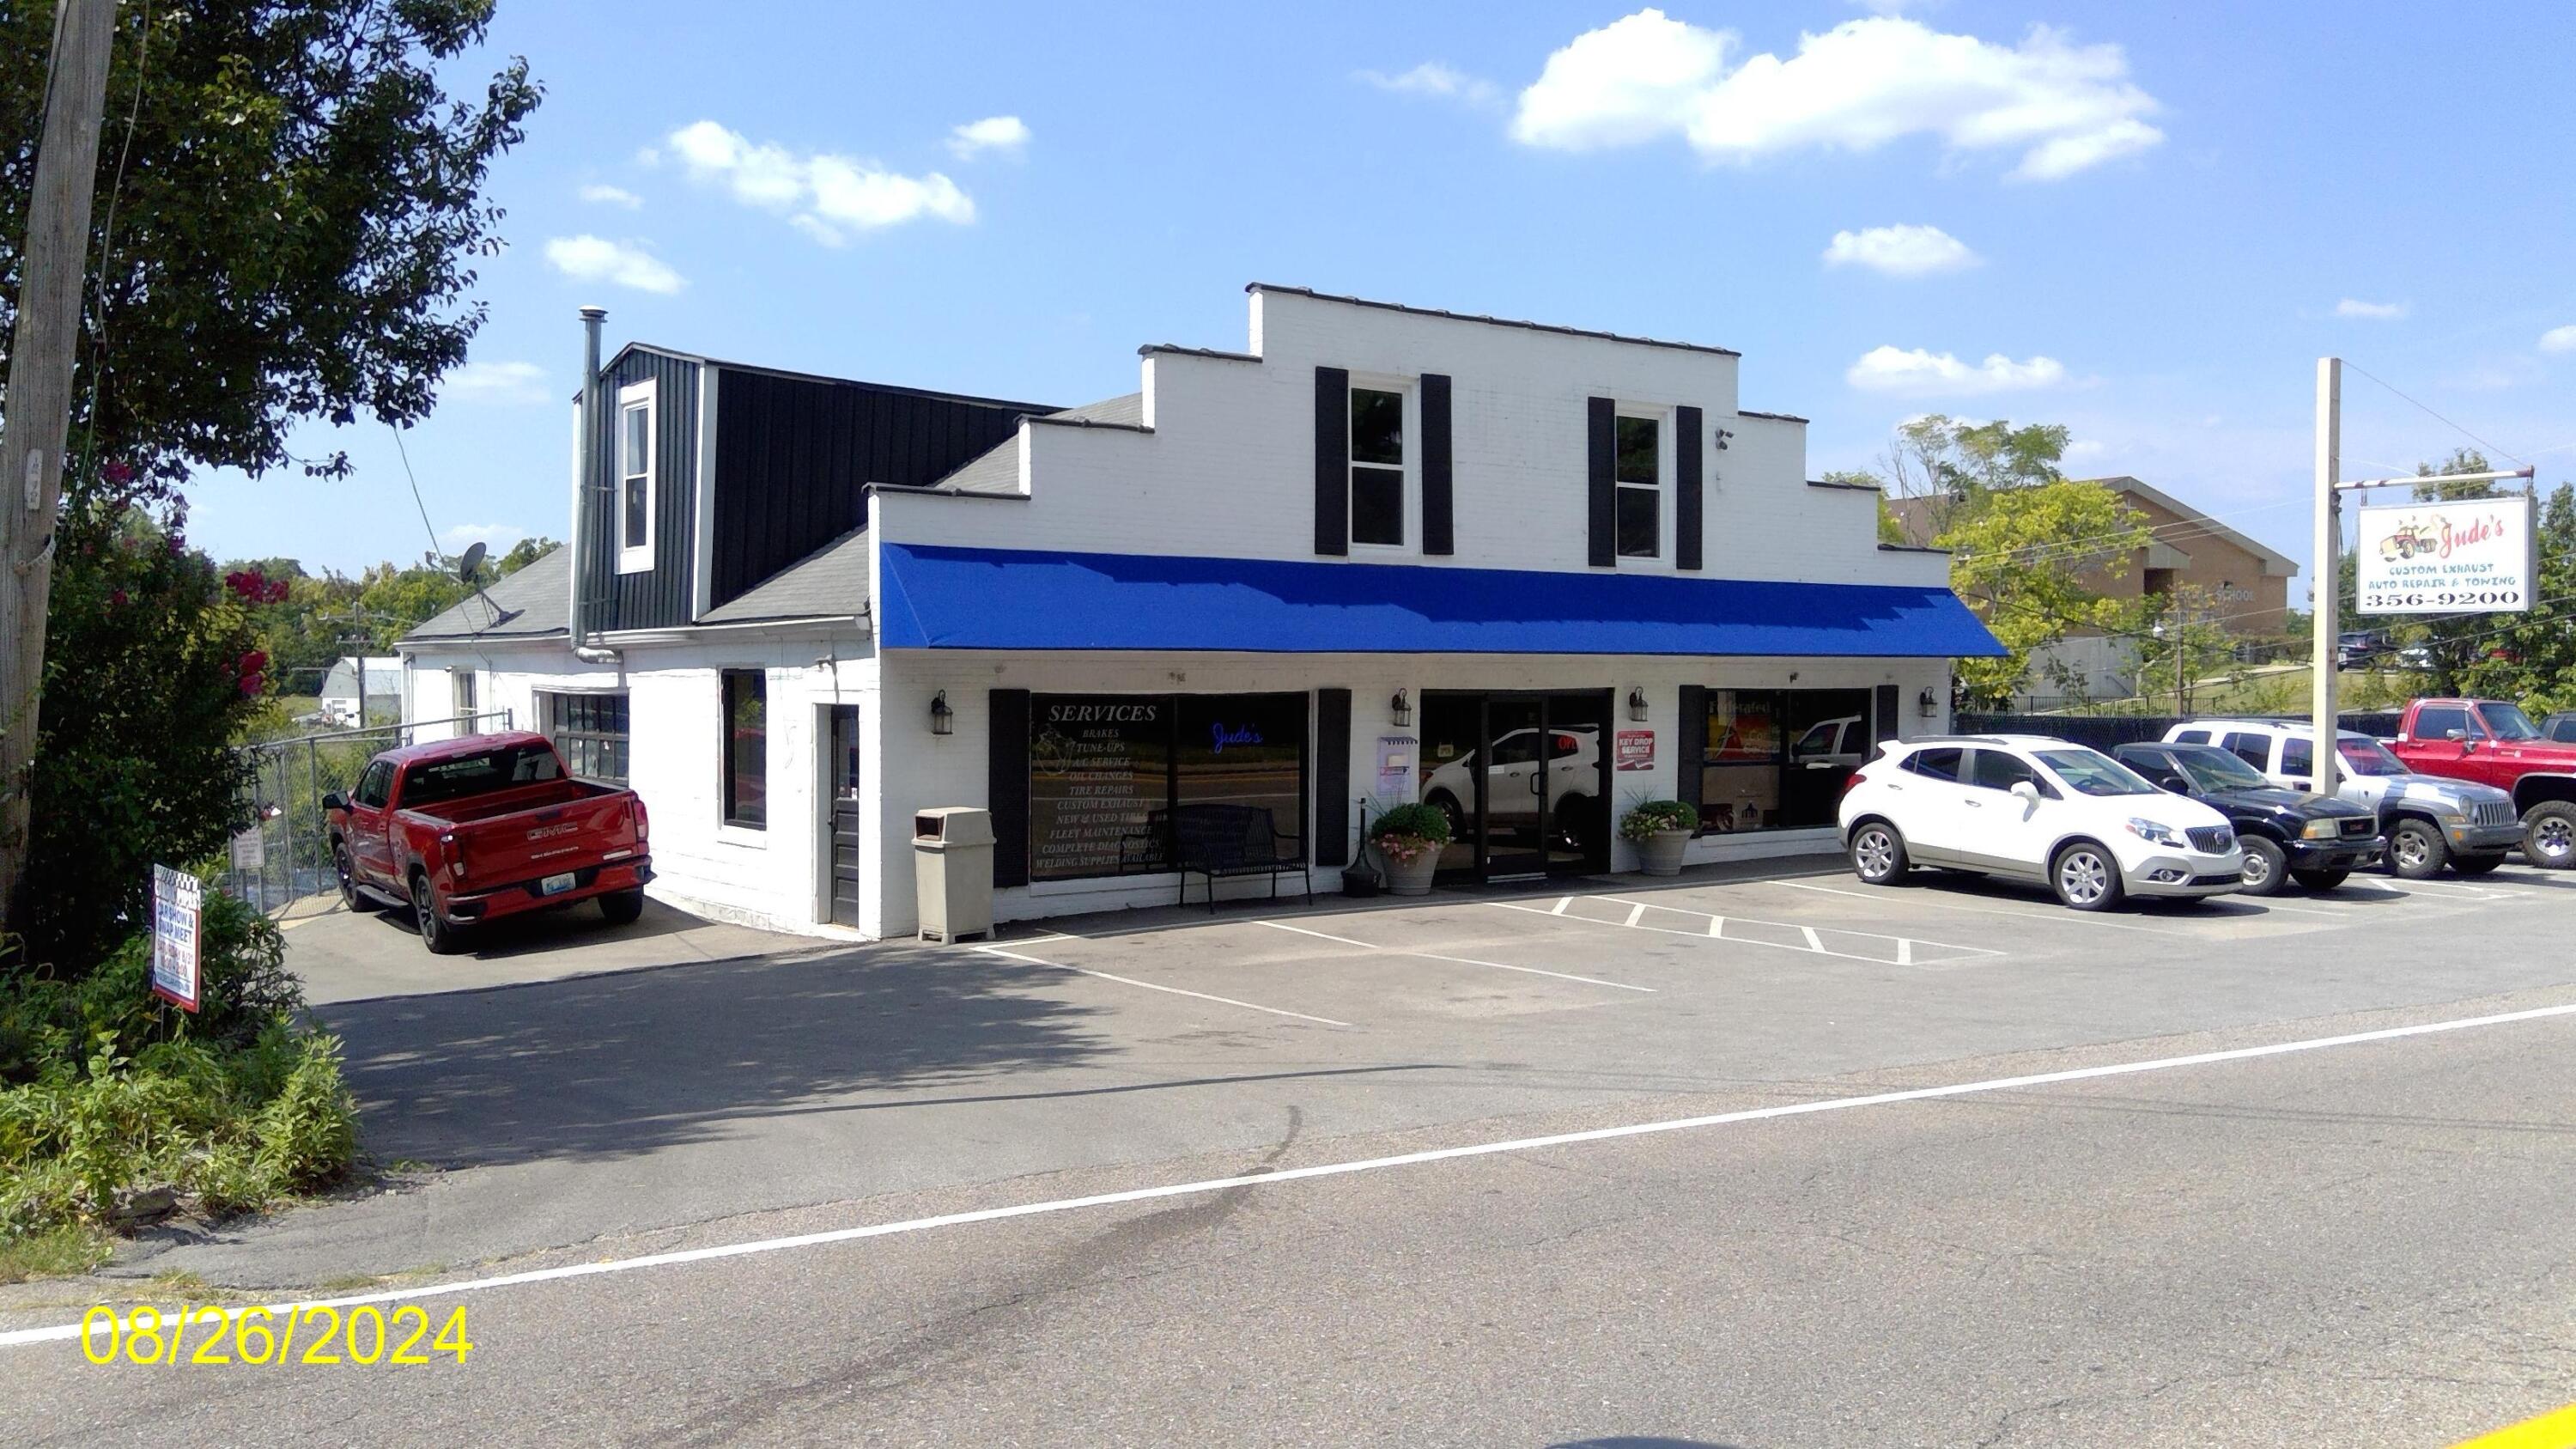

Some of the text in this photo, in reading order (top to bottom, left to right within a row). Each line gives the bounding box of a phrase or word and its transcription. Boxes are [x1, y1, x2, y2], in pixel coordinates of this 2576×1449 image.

[2439, 514, 2504, 559] Jude's
[2390, 563, 2494, 575] CUSTOM EXHAUST
[2368, 576, 2516, 590] AUTO REPAIR & TOWING
[2366, 591, 2519, 607] 356-9200
[1048, 704, 1157, 721] SERVICES
[1082, 728, 1121, 739] BRAKES
[1212, 722, 1264, 754] Jude's
[1077, 742, 1126, 752] TUNE-UPS
[1619, 738, 1653, 746] KEY DROP
[1621, 746, 1650, 754] SERVICE
[1090, 757, 1131, 767] SERVICE
[1089, 771, 1133, 781] CHANGES
[1069, 785, 1134, 795] TIRE REPAIRS
[1057, 799, 1144, 810] CUSTOM EXHAUST
[1055, 813, 1080, 825] NEW
[1080, 813, 1090, 824] &
[1092, 813, 1118, 824] USED
[526, 821, 579, 841] GMC
[1049, 829, 1081, 839] FLEET
[1042, 842, 1095, 855] COMPLETE
[1036, 857, 1078, 869] WELDING
